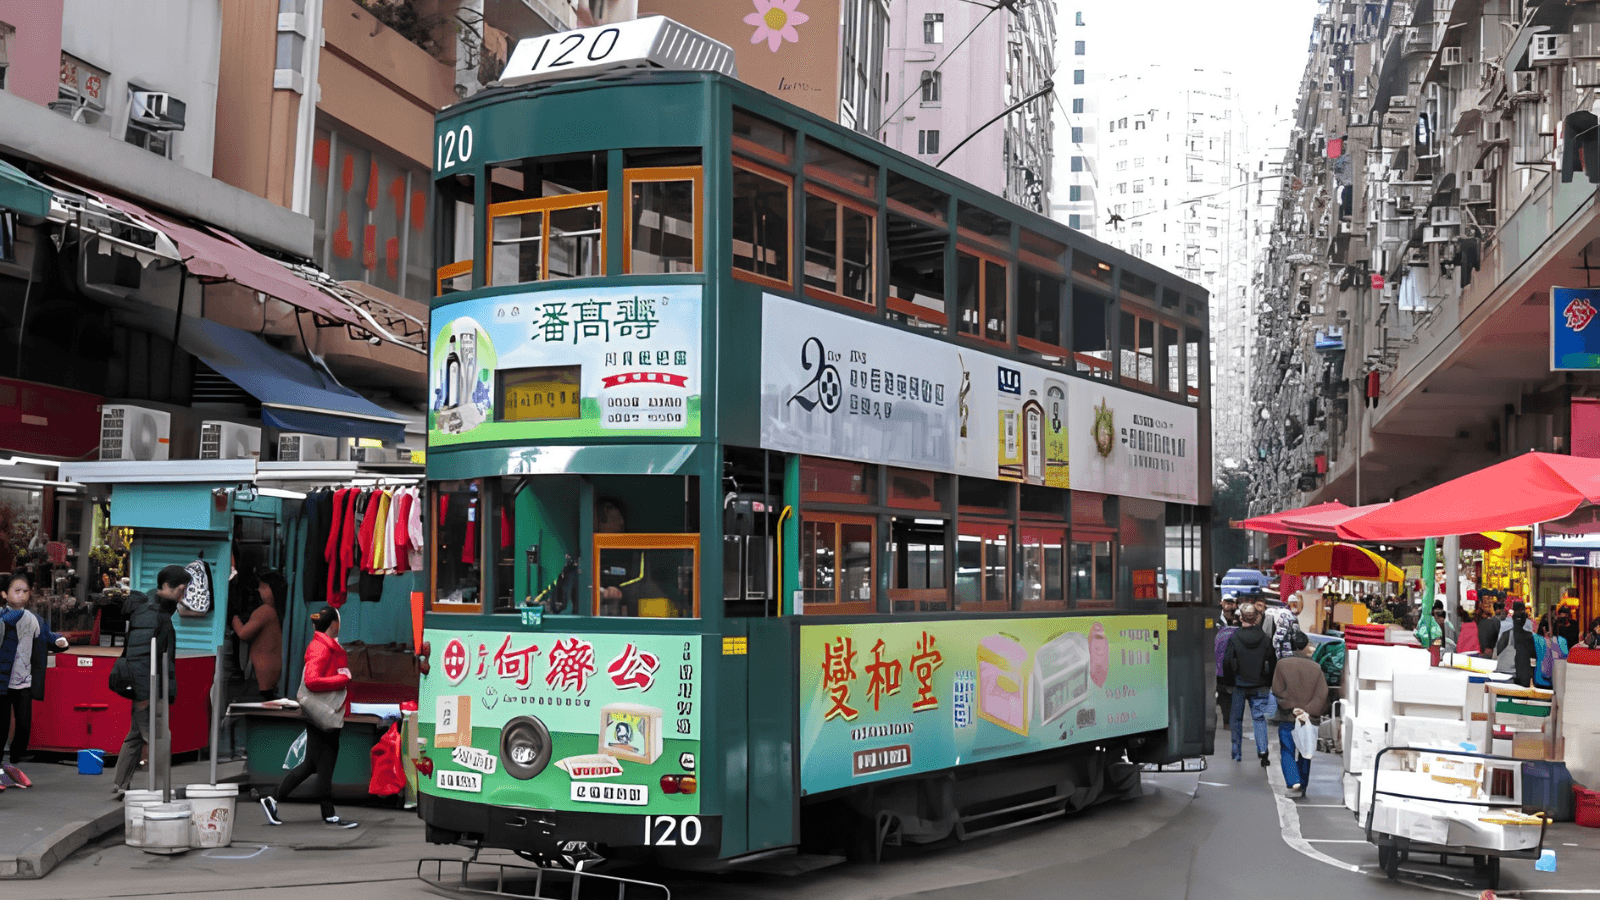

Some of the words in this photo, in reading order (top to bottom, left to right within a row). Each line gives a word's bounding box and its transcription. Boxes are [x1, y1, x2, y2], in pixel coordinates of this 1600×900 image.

[530, 27, 620, 71] 120
[437, 124, 473, 172] 120
[643, 815, 702, 846] 120
